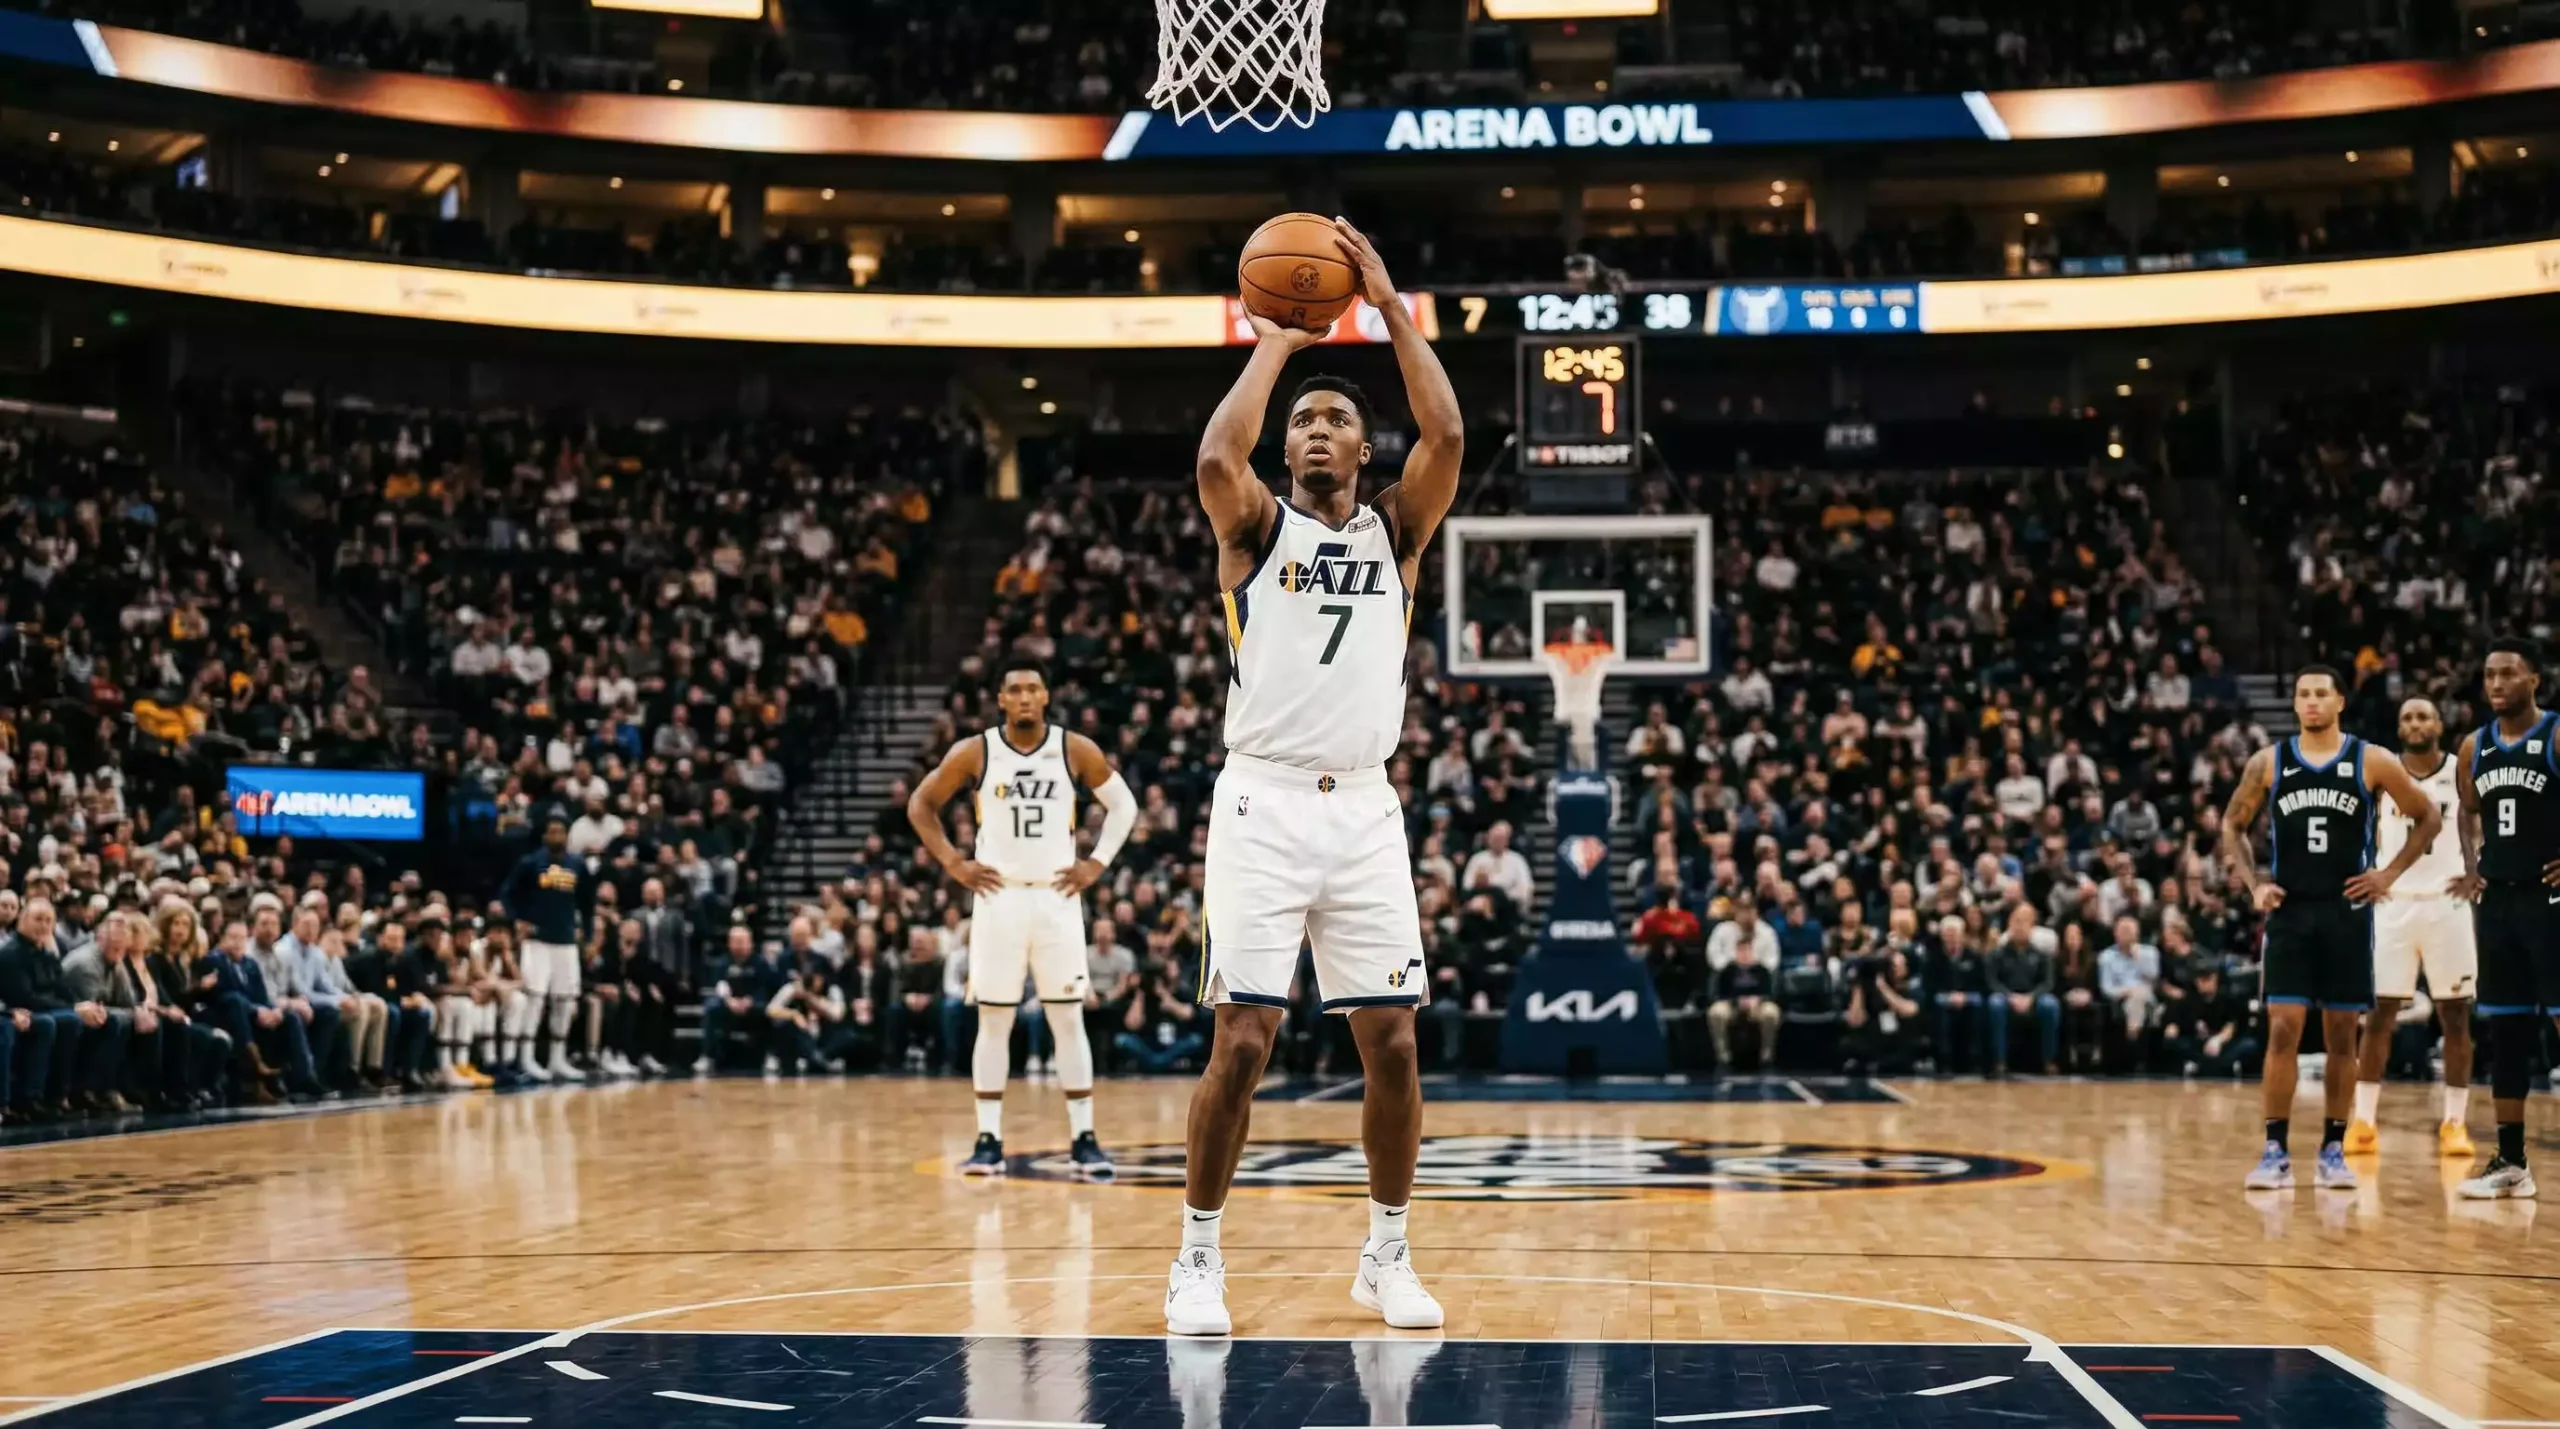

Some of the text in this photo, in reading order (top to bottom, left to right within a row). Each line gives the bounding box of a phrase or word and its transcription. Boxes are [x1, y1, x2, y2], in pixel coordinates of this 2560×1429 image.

[1385, 104, 1713, 150] ARENA BOWL
[1460, 297, 1488, 333] 7
[1518, 294, 1619, 330] 12:45
[1543, 346, 1624, 382] 12:45
[1582, 381, 1614, 434] 7
[1318, 605, 1353, 664] 7
[1010, 806, 1043, 838] 12
[2308, 816, 2328, 853] 5
[2498, 798, 2516, 836] 9
